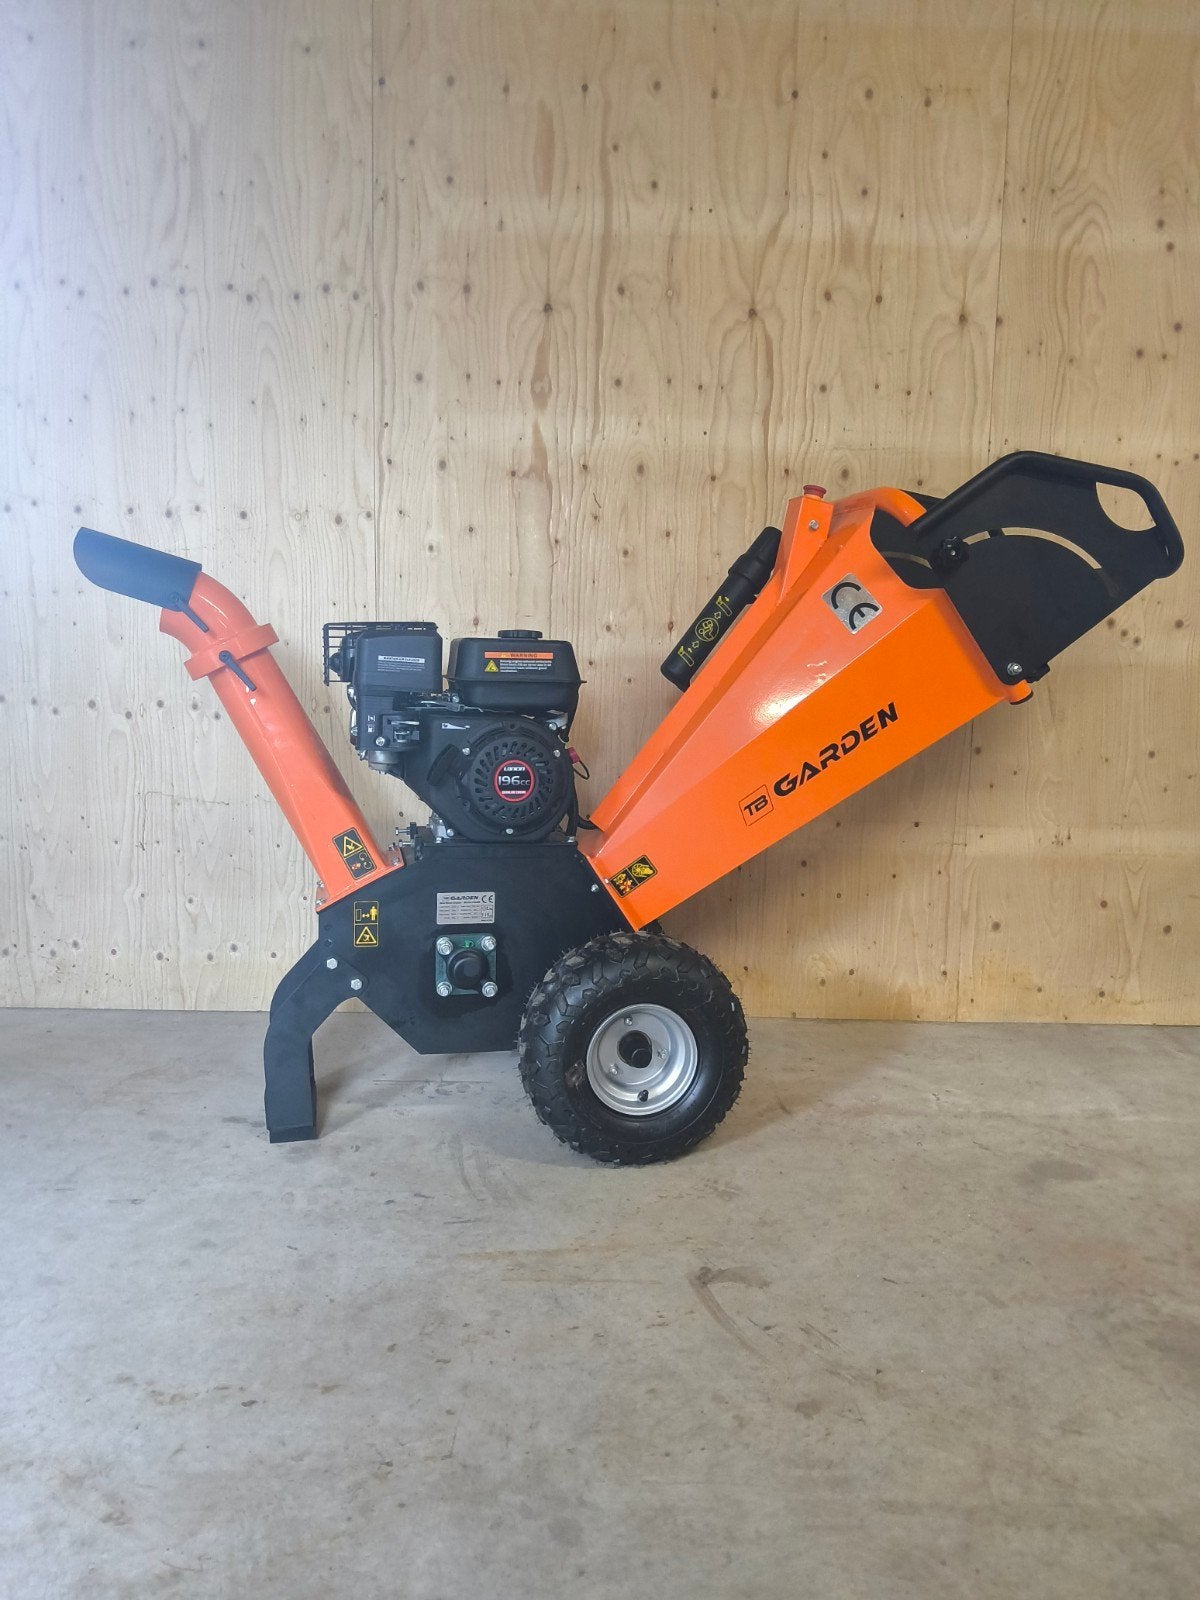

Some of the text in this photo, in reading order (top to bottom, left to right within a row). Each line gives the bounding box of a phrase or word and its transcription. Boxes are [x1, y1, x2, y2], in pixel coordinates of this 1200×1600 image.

[831, 582, 879, 630] CE
[498, 775, 531, 786] 196cc
[743, 702, 898, 816] TB GARDEN
